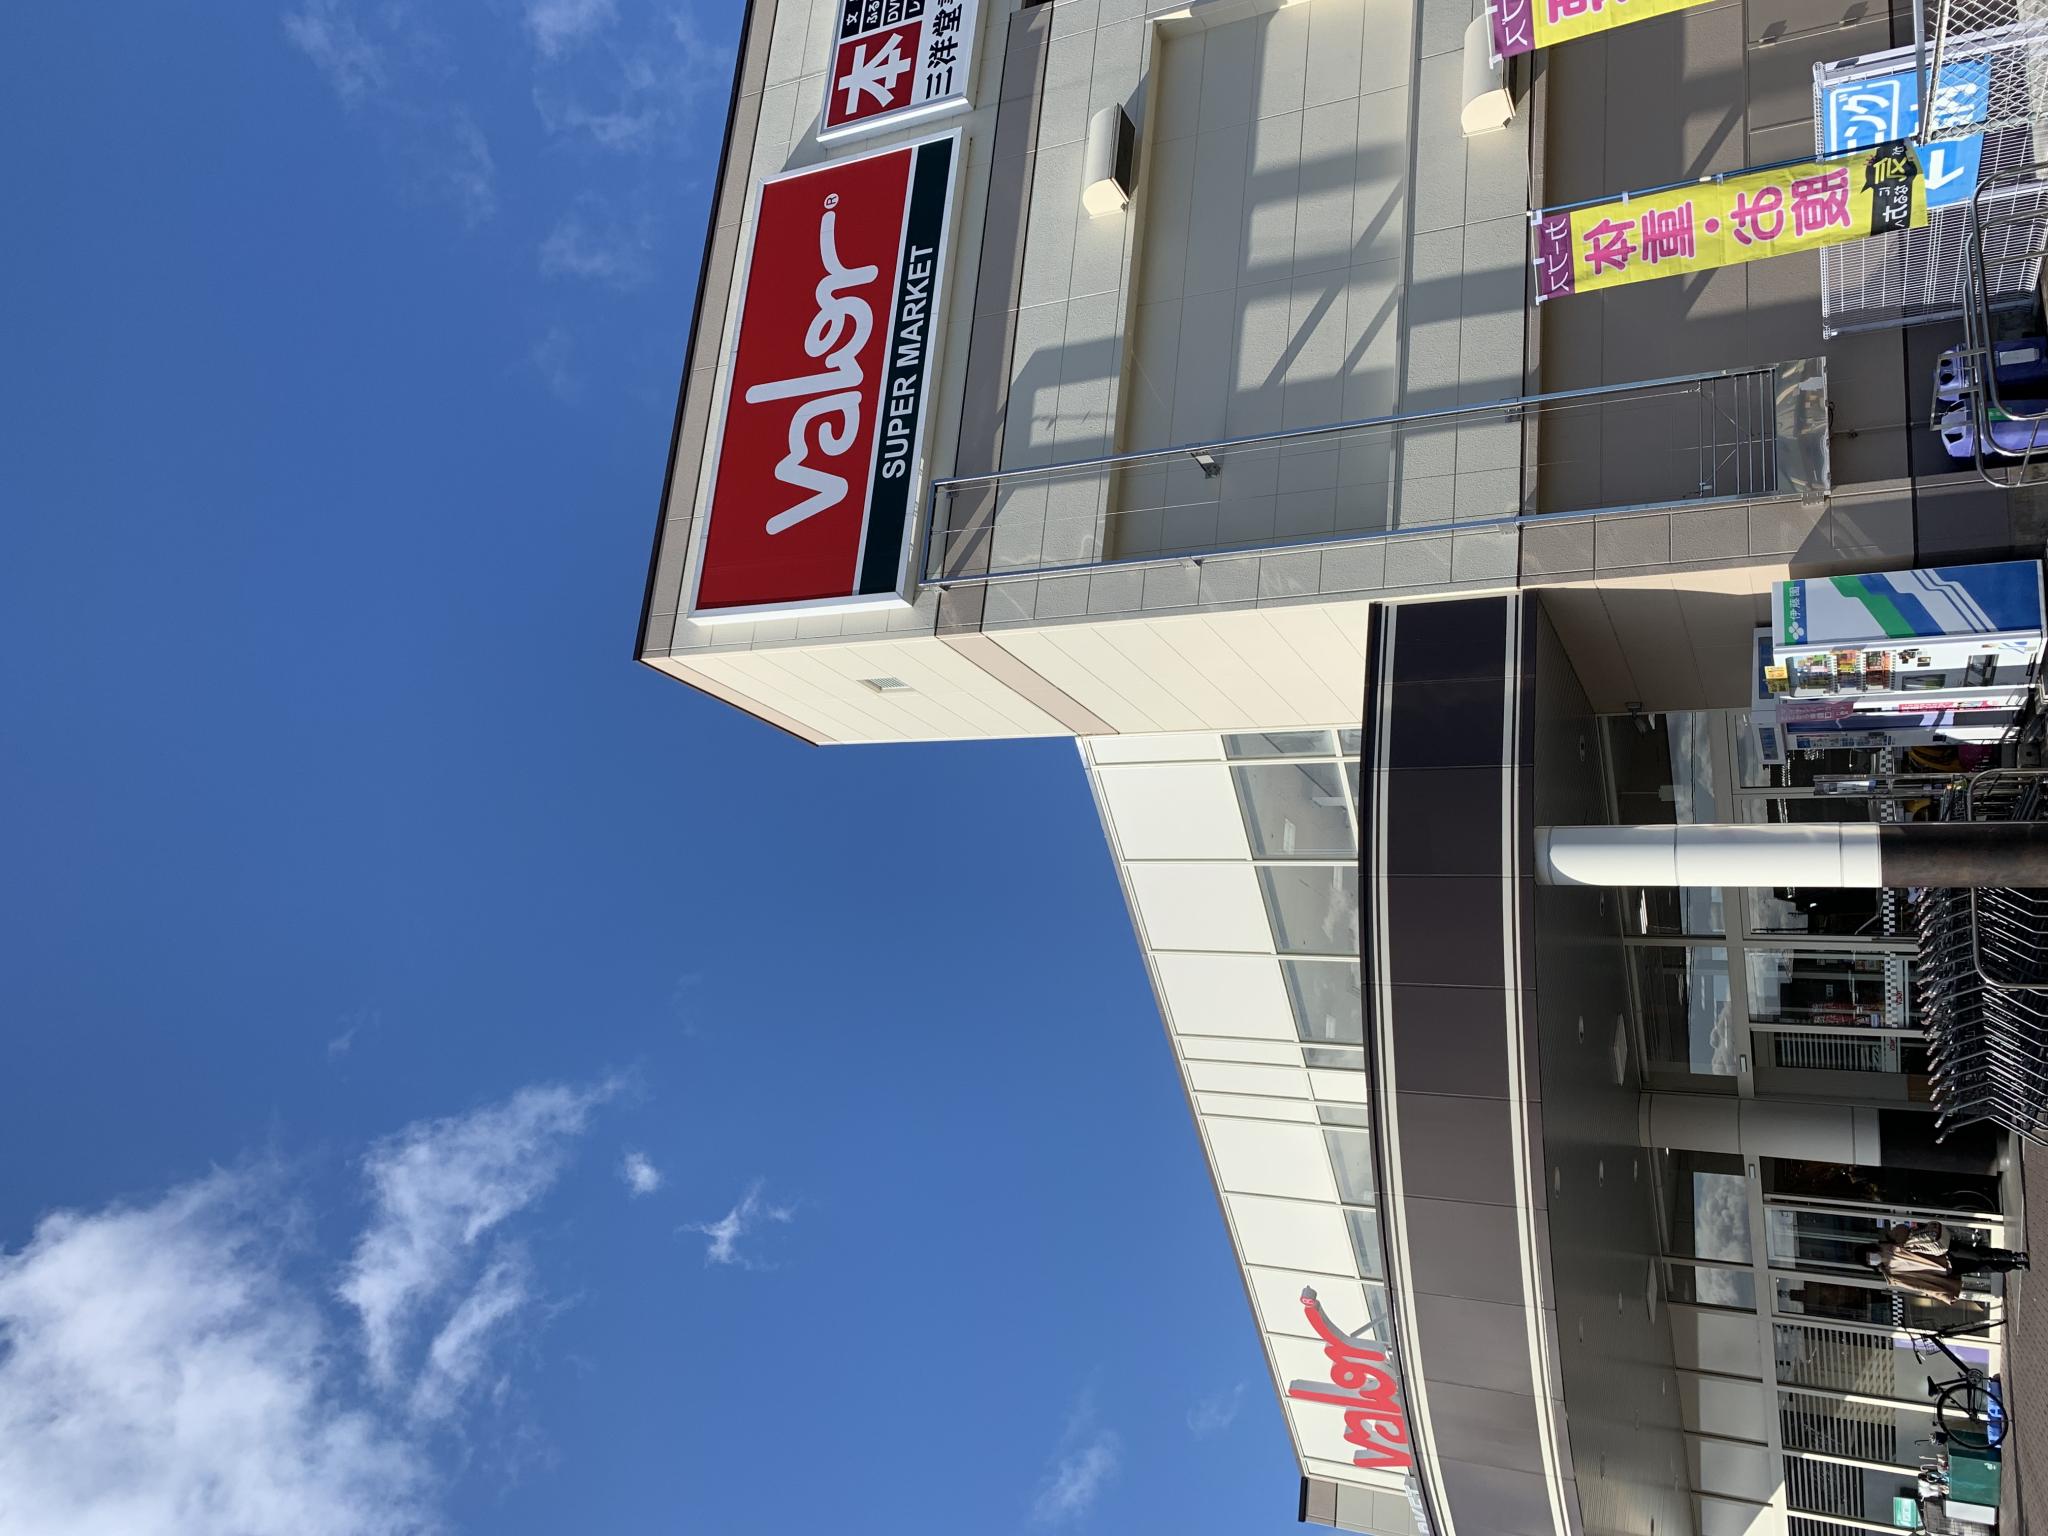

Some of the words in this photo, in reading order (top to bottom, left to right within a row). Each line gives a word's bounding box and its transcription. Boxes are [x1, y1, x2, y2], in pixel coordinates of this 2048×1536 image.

[866, 0, 880, 23] ふる
[887, 0, 901, 23] DV
[837, 32, 912, 116] 本
[898, 244, 934, 367] MARKET
[745, 211, 879, 535] valor
[882, 374, 918, 479] SUPER
